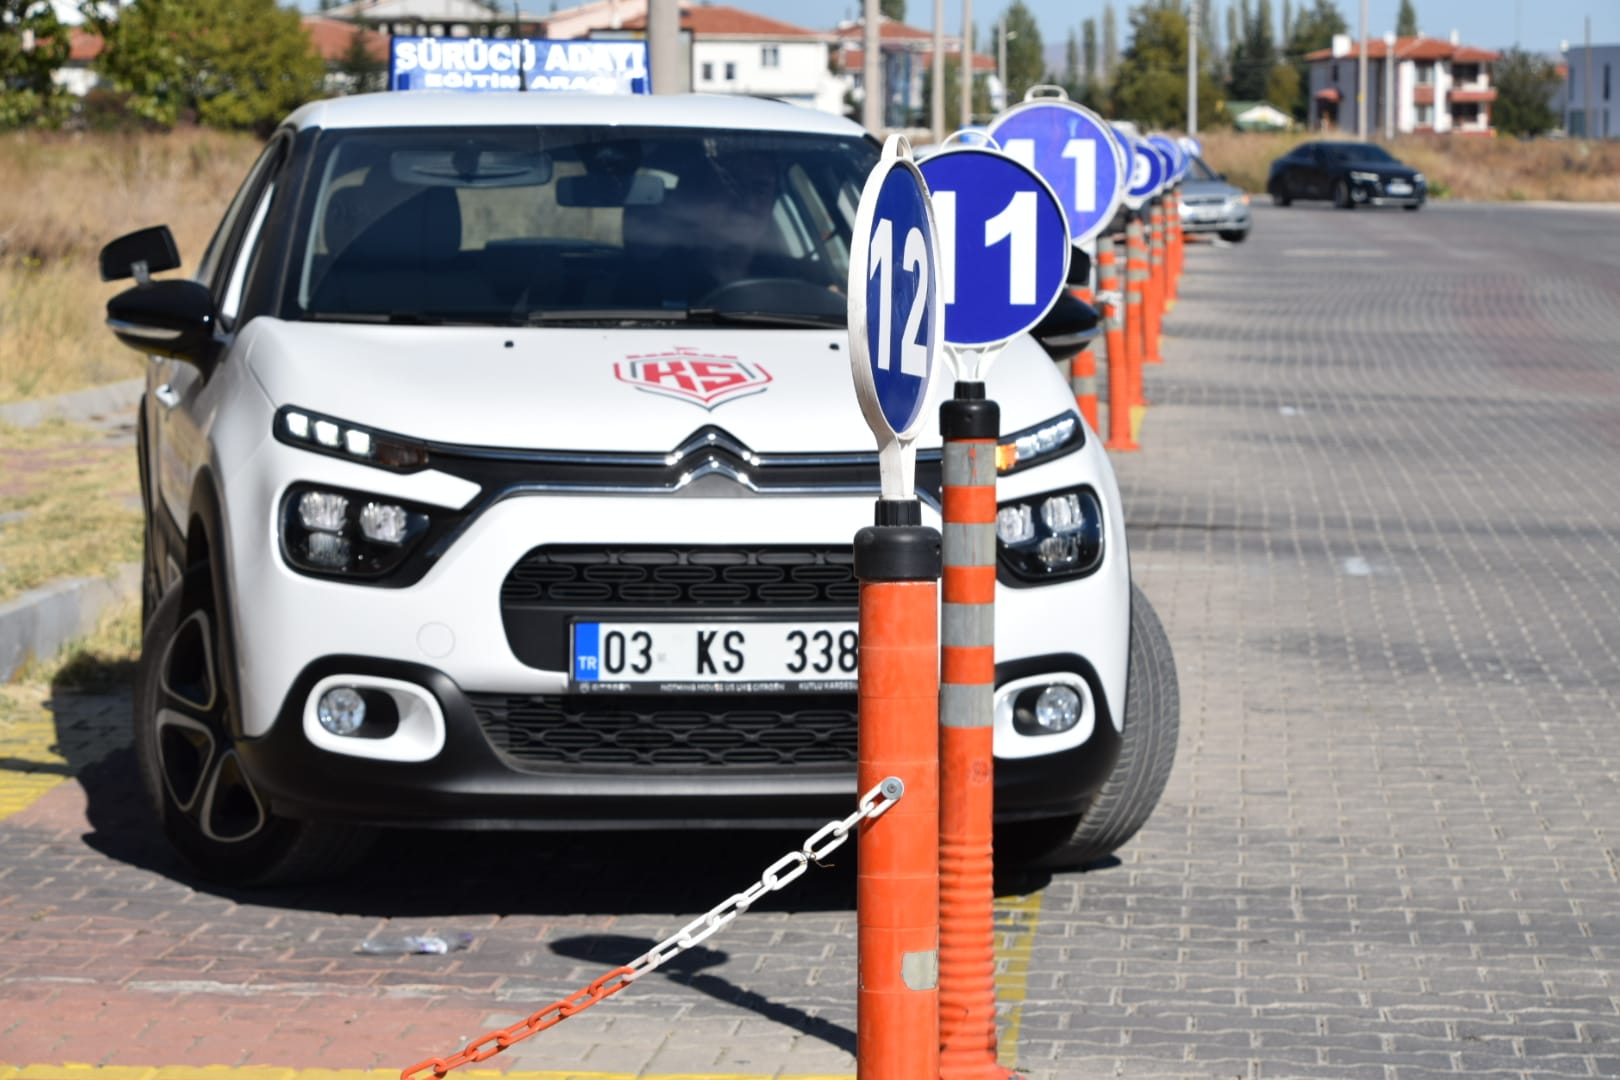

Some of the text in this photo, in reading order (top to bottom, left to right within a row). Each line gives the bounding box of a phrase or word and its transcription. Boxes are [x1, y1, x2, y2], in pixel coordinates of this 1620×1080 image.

[395, 37, 645, 71] SÜRÜCÜ ADAYI
[869, 217, 929, 378] 12
[642, 360, 748, 393] KS
[578, 656, 597, 670] TR
[604, 629, 859, 675] 03 KS 338
